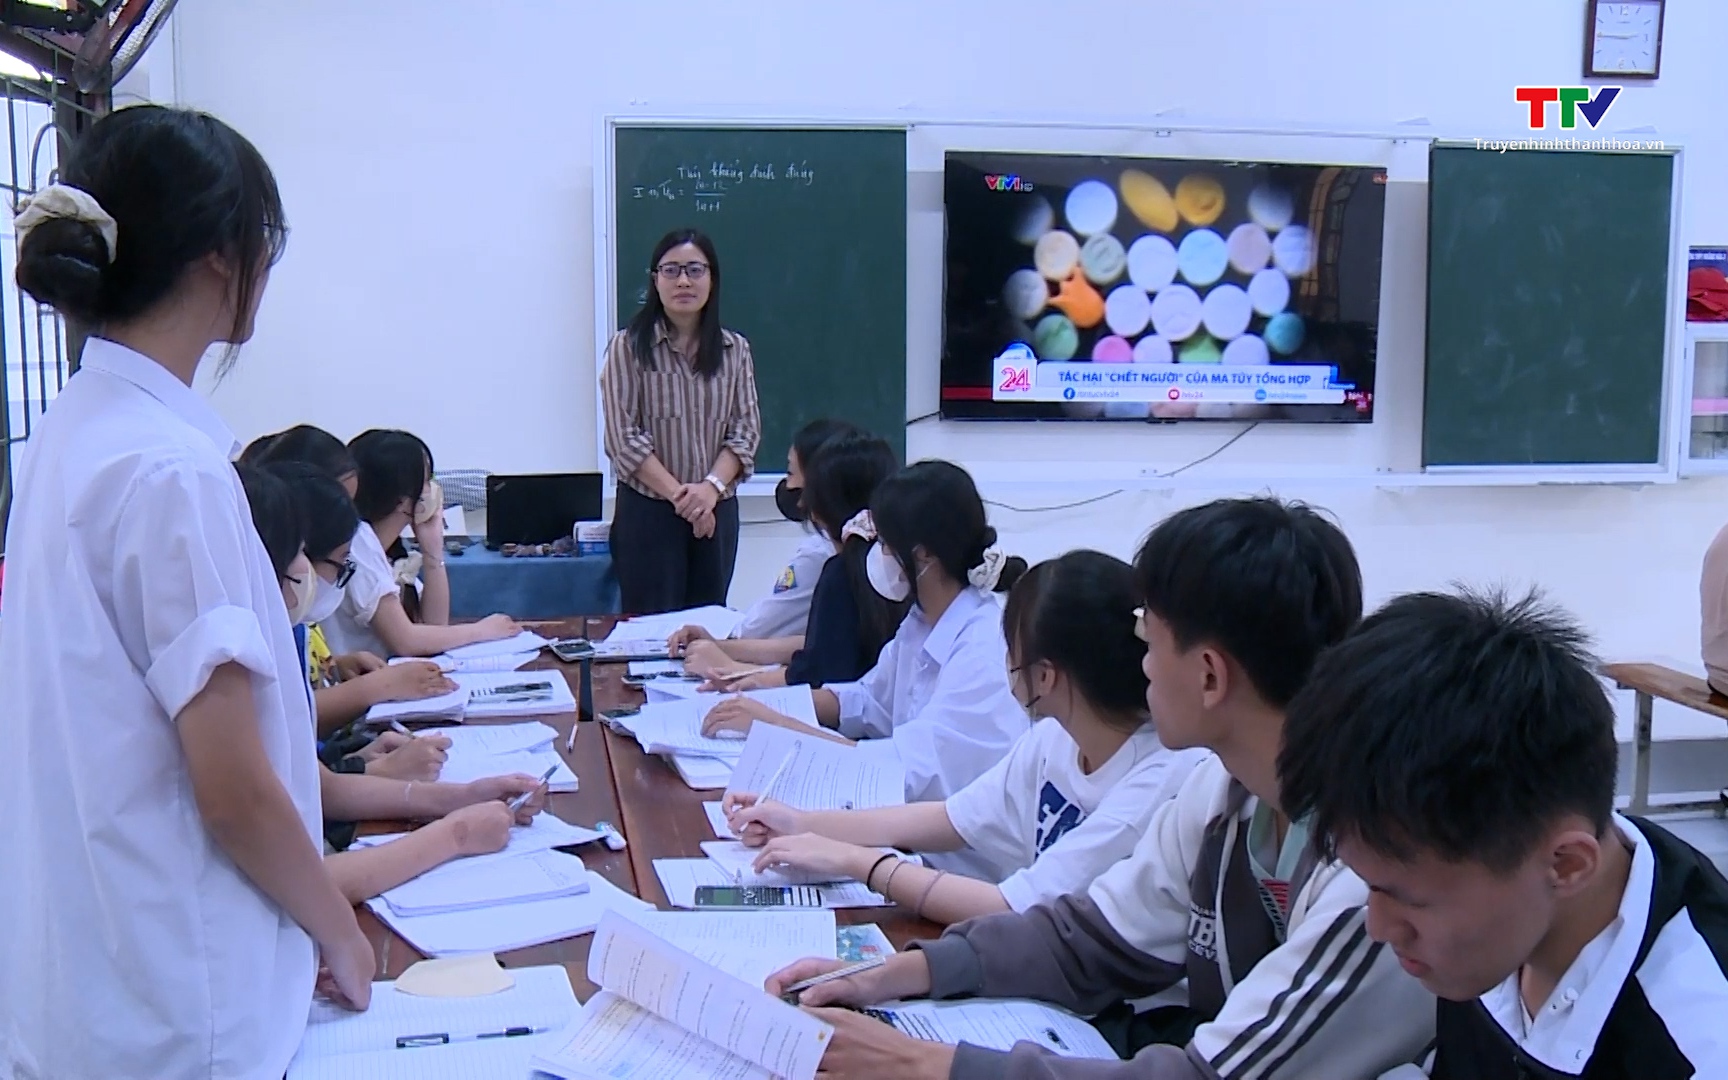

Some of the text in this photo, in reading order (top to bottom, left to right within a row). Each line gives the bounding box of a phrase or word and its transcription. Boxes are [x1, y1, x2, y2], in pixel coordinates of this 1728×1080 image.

[999, 367, 1031, 392] 24
[1058, 369, 1080, 382] TÁC
[1211, 373, 1229, 384] MA
